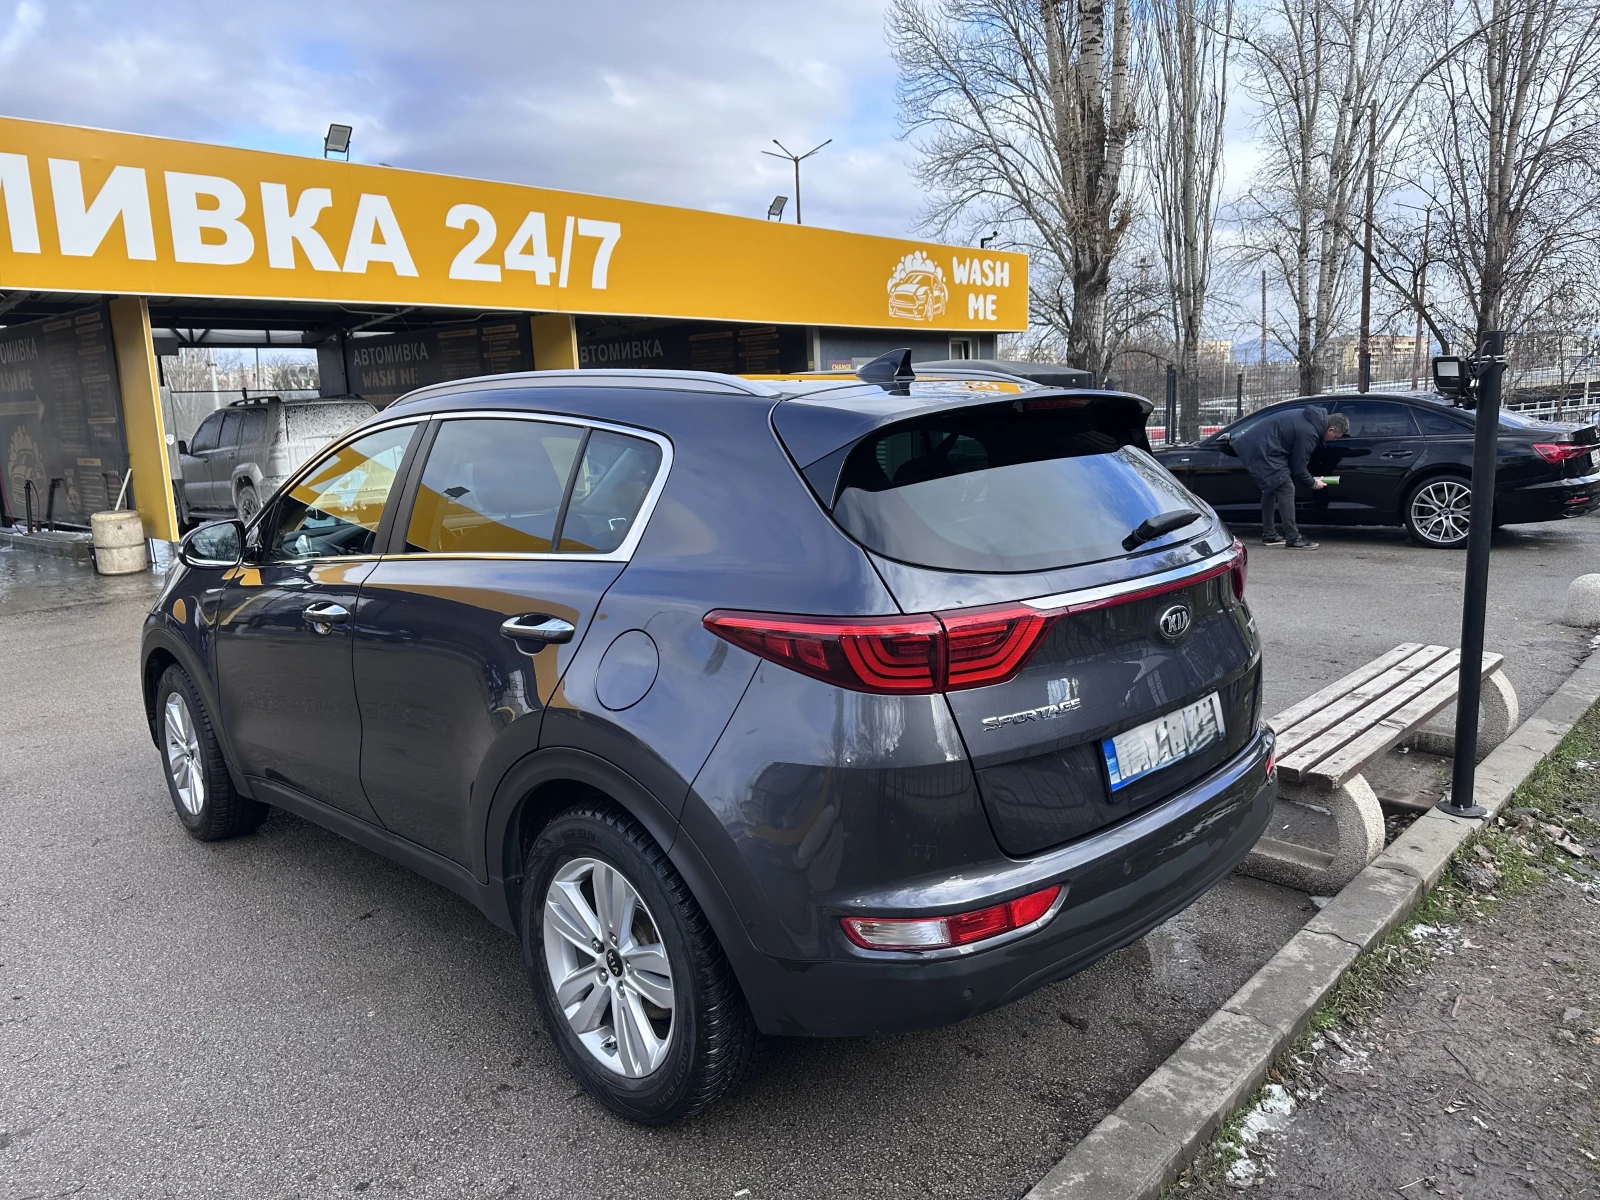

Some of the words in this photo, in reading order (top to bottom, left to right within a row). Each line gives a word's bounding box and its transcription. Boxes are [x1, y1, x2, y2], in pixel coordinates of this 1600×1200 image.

[444, 203, 622, 290] 24/7
[952, 256, 1010, 288] WASH
[967, 293, 998, 321] ME
[353, 341, 429, 366] АВТОМИВКА
[579, 338, 664, 364] ВТОМИВКА
[19, 369, 34, 391] ME
[361, 369, 397, 388] WASH
[400, 367, 418, 385] ME
[1167, 610, 1188, 635] KIA
[981, 697, 1082, 732] SPORTAGE
[607, 952, 619, 975] KIA
